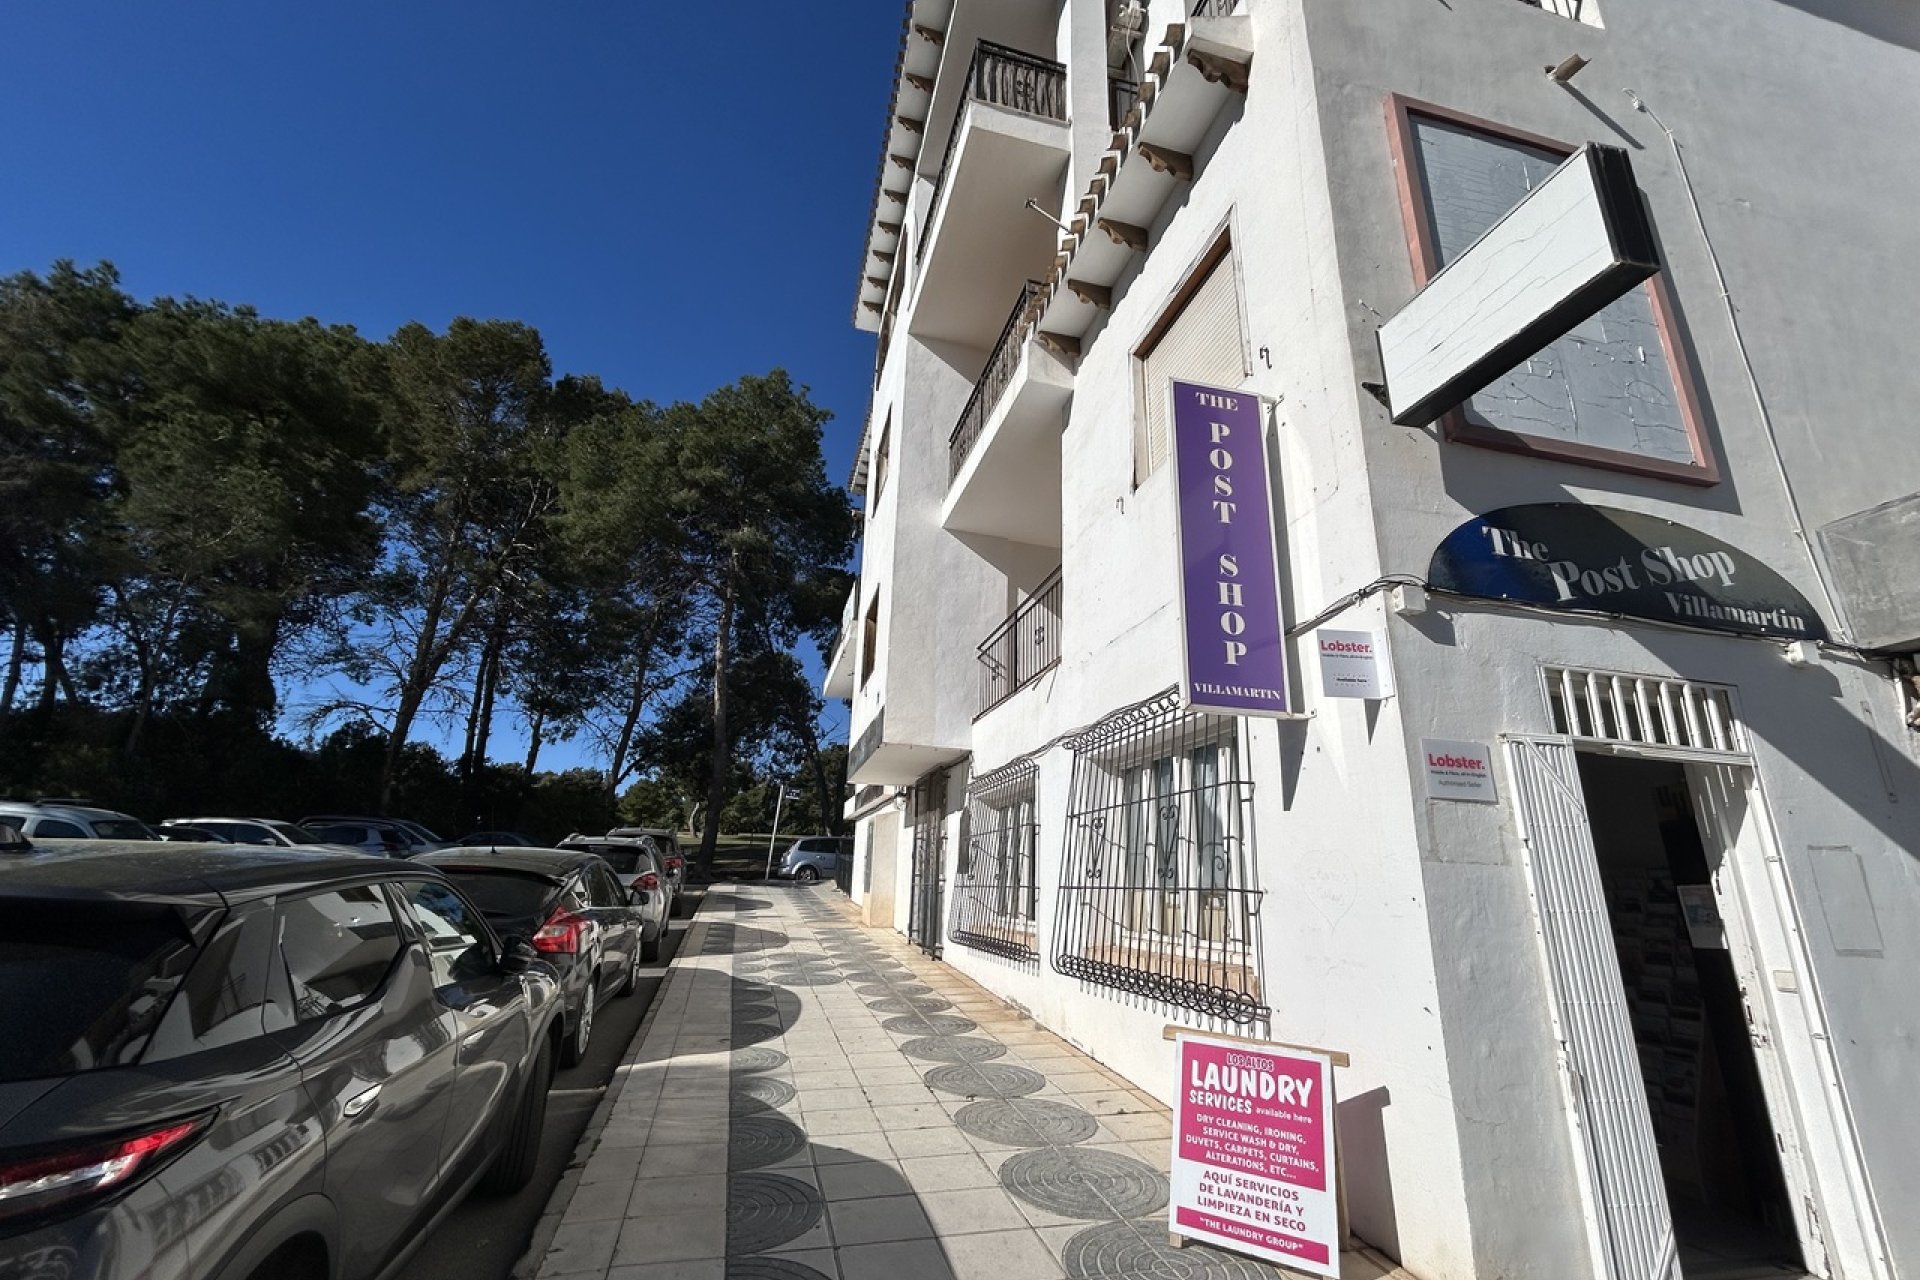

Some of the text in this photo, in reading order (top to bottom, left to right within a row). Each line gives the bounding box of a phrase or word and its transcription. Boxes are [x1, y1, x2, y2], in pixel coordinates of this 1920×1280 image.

[1195, 392, 1238, 412] THE
[1209, 422, 1237, 524] POST
[1481, 525, 1549, 562] The
[1545, 546, 1736, 602] Post Shop
[1217, 554, 1247, 665] SHOP
[1664, 591, 1806, 631] Villamartin
[1321, 640, 1372, 653] Lobster.
[1194, 682, 1281, 700] VILLAMARTIN
[1428, 753, 1486, 770] Lobster.
[1227, 1052, 1275, 1072] LOS ALTOS
[1191, 1059, 1313, 1108] LAUNDRY
[1189, 1089, 1312, 1124] SERVICES available here
[1196, 1113, 1307, 1144] DRY CLEANING, IRONING,
[1202, 1126, 1299, 1155] SERVICE WASH & DRY,
[1186, 1134, 1319, 1172] DUVETS, CARPETS, CURTAINS,
[1205, 1150, 1268, 1173] ALTERATIONS,
[1200, 1183, 1304, 1217] DE LAVANDERÍA Y
[1203, 1170, 1300, 1201] AQUÍ SERVICIOS
[1197, 1196, 1306, 1232] LIMPIEZA EN SECO
[1222, 1222, 1264, 1242] LAUNDRY
